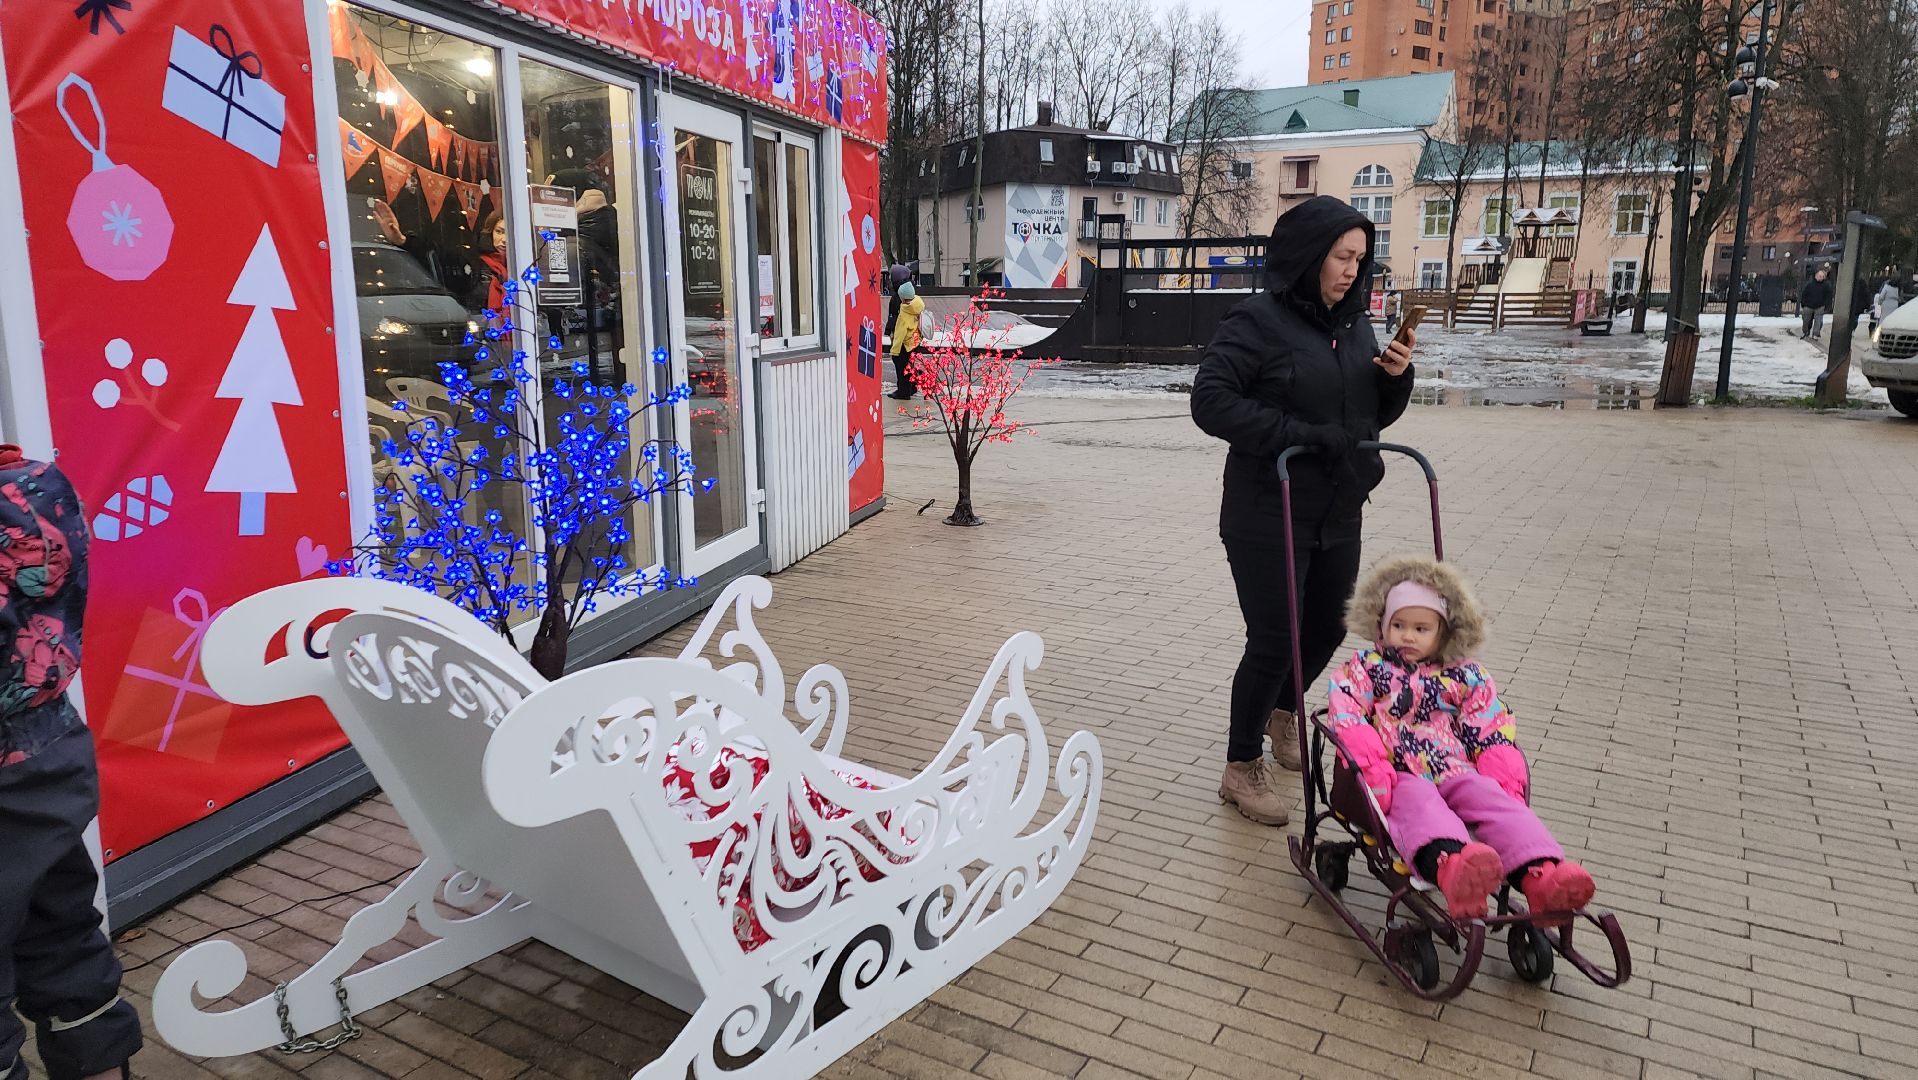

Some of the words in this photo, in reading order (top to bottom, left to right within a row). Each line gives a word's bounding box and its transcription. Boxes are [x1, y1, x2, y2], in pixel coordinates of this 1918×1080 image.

[690, 222, 715, 239] 10-20
[1012, 222, 1062, 236] ТОЧКА
[691, 245, 716, 260] 10-21
